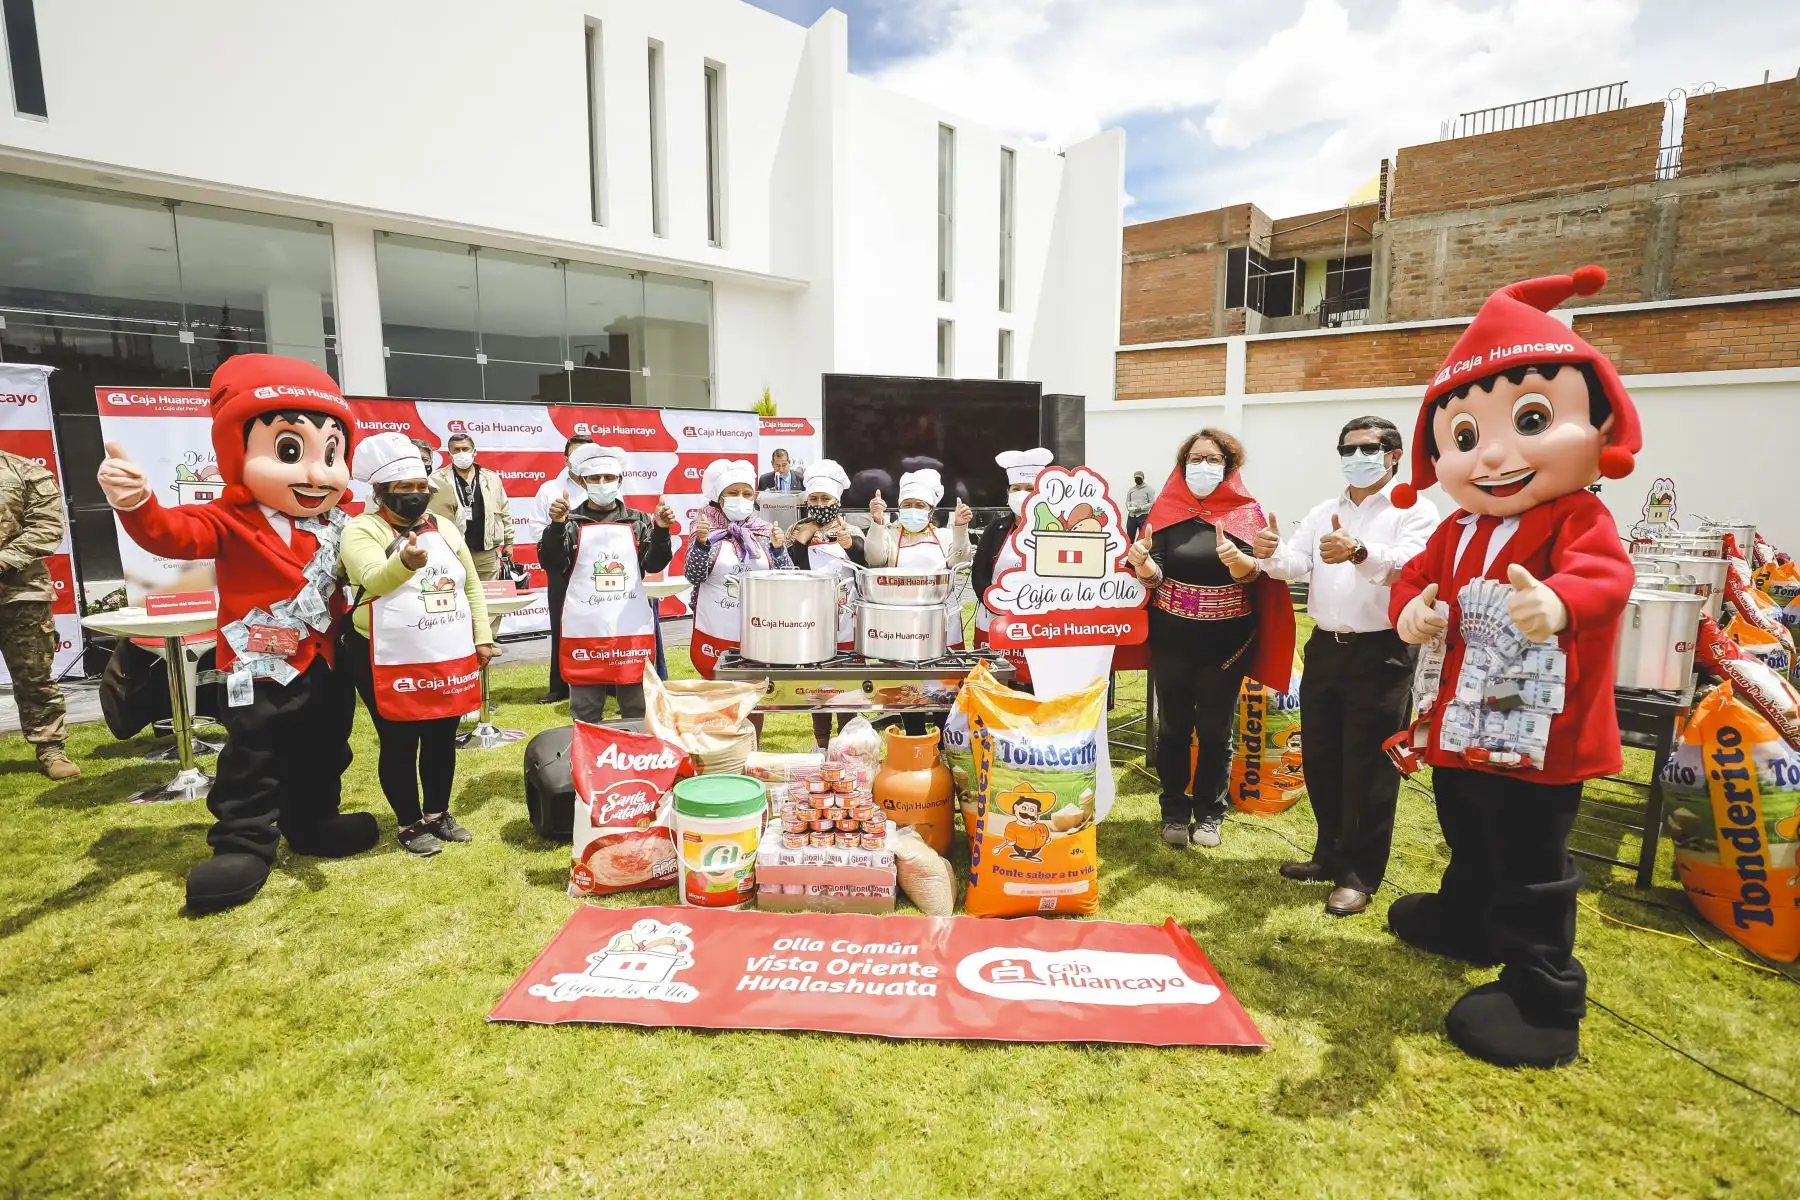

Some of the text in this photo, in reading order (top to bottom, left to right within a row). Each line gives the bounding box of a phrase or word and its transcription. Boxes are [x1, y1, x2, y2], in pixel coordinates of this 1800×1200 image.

[1453, 342, 1574, 375] Caja Huancayo
[130, 394, 157, 406] Caja
[277, 386, 305, 397] Caja
[467, 422, 543, 435] Caja Huancayo
[591, 424, 656, 436] Caja Huancayo
[697, 427, 753, 439] Caja Huancayo
[765, 421, 804, 429] Caja Huancayo
[622, 469, 658, 479] uancayo
[1046, 478, 1096, 505] De la
[889, 577, 905, 587] Caja
[714, 598, 736, 609] Caja
[998, 579, 1139, 610] Caja a la Olla
[761, 619, 816, 630] Caja Huancayo
[1031, 622, 1132, 641] Caja Huancayo
[878, 630, 930, 641] Caja Huancayo
[590, 649, 610, 661] Caja
[1719, 658, 1749, 688] Avena
[417, 678, 445, 691] Caja
[1239, 679, 1265, 801] Tonderit
[596, 743, 681, 771] Avena
[606, 790, 646, 809] Santa
[599, 800, 656, 825] Catalina
[1711, 725, 1775, 930] Tonderito
[992, 864, 1024, 878] Ponte
[1026, 871, 1058, 880] sabor
[1067, 869, 1079, 878] tu
[772, 937, 919, 955] Olla Común
[745, 954, 940, 978] Vista Oriente
[1047, 959, 1092, 979] Caja
[735, 974, 938, 997] Hualashuata
[1048, 972, 1186, 993] Huancayo
